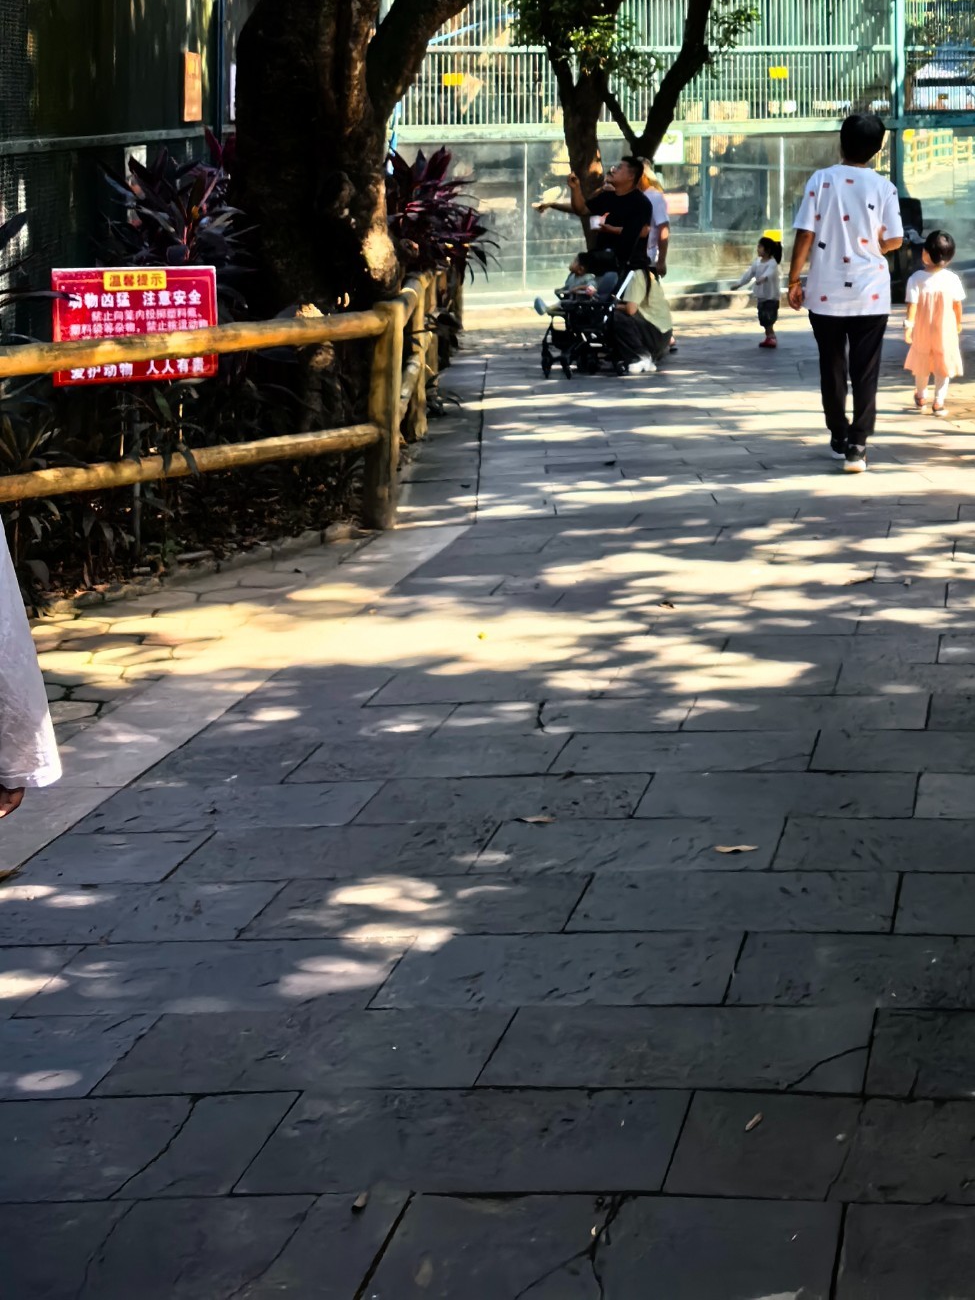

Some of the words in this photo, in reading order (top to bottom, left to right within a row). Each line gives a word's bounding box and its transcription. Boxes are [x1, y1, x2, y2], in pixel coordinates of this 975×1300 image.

[109, 273, 163, 287] 温馨提示
[68, 291, 131, 310] 动物凶猛
[142, 289, 202, 306] 注意安全
[70, 362, 134, 381] 爱护动物
[145, 357, 205, 376] 人人有责
